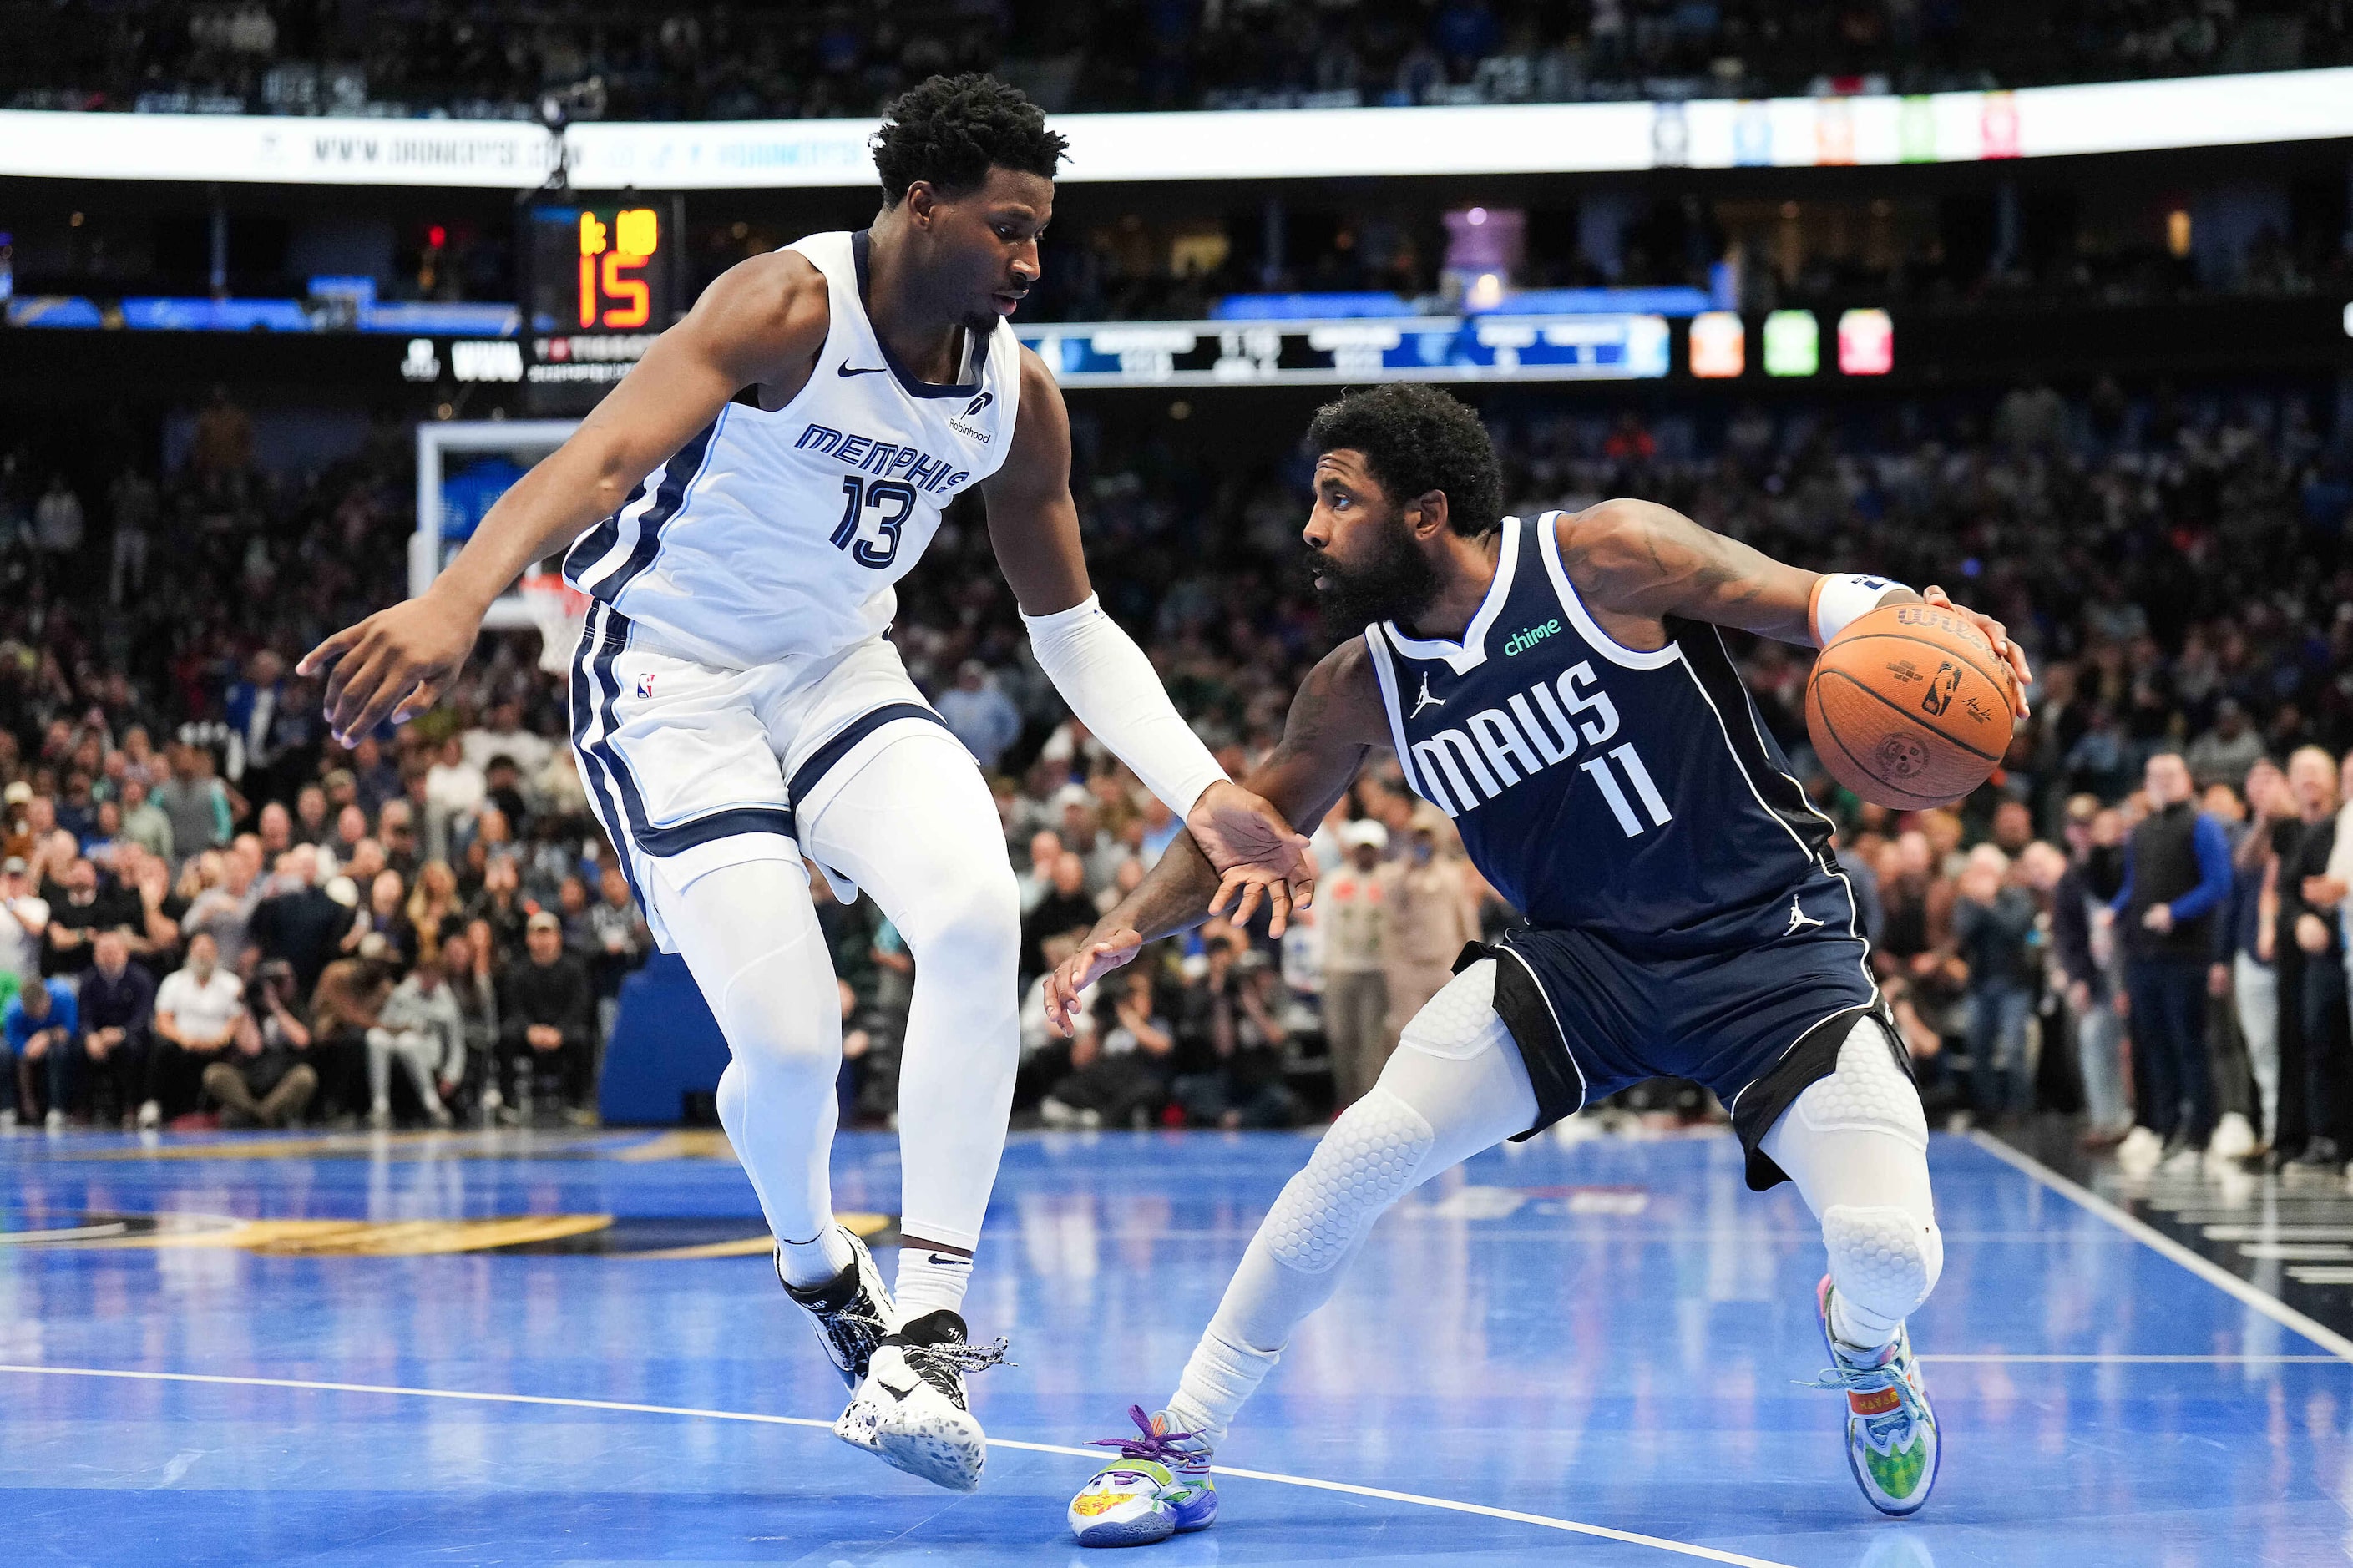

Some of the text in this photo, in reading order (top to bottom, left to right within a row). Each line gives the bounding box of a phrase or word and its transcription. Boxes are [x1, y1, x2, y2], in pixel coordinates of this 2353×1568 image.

[579, 250, 650, 328] 15
[794, 423, 970, 494] MEMPHIS
[949, 418, 991, 443] Robinhood
[829, 475, 917, 569] 13
[1504, 618, 1562, 657] chime
[1579, 742, 1672, 838] 11
